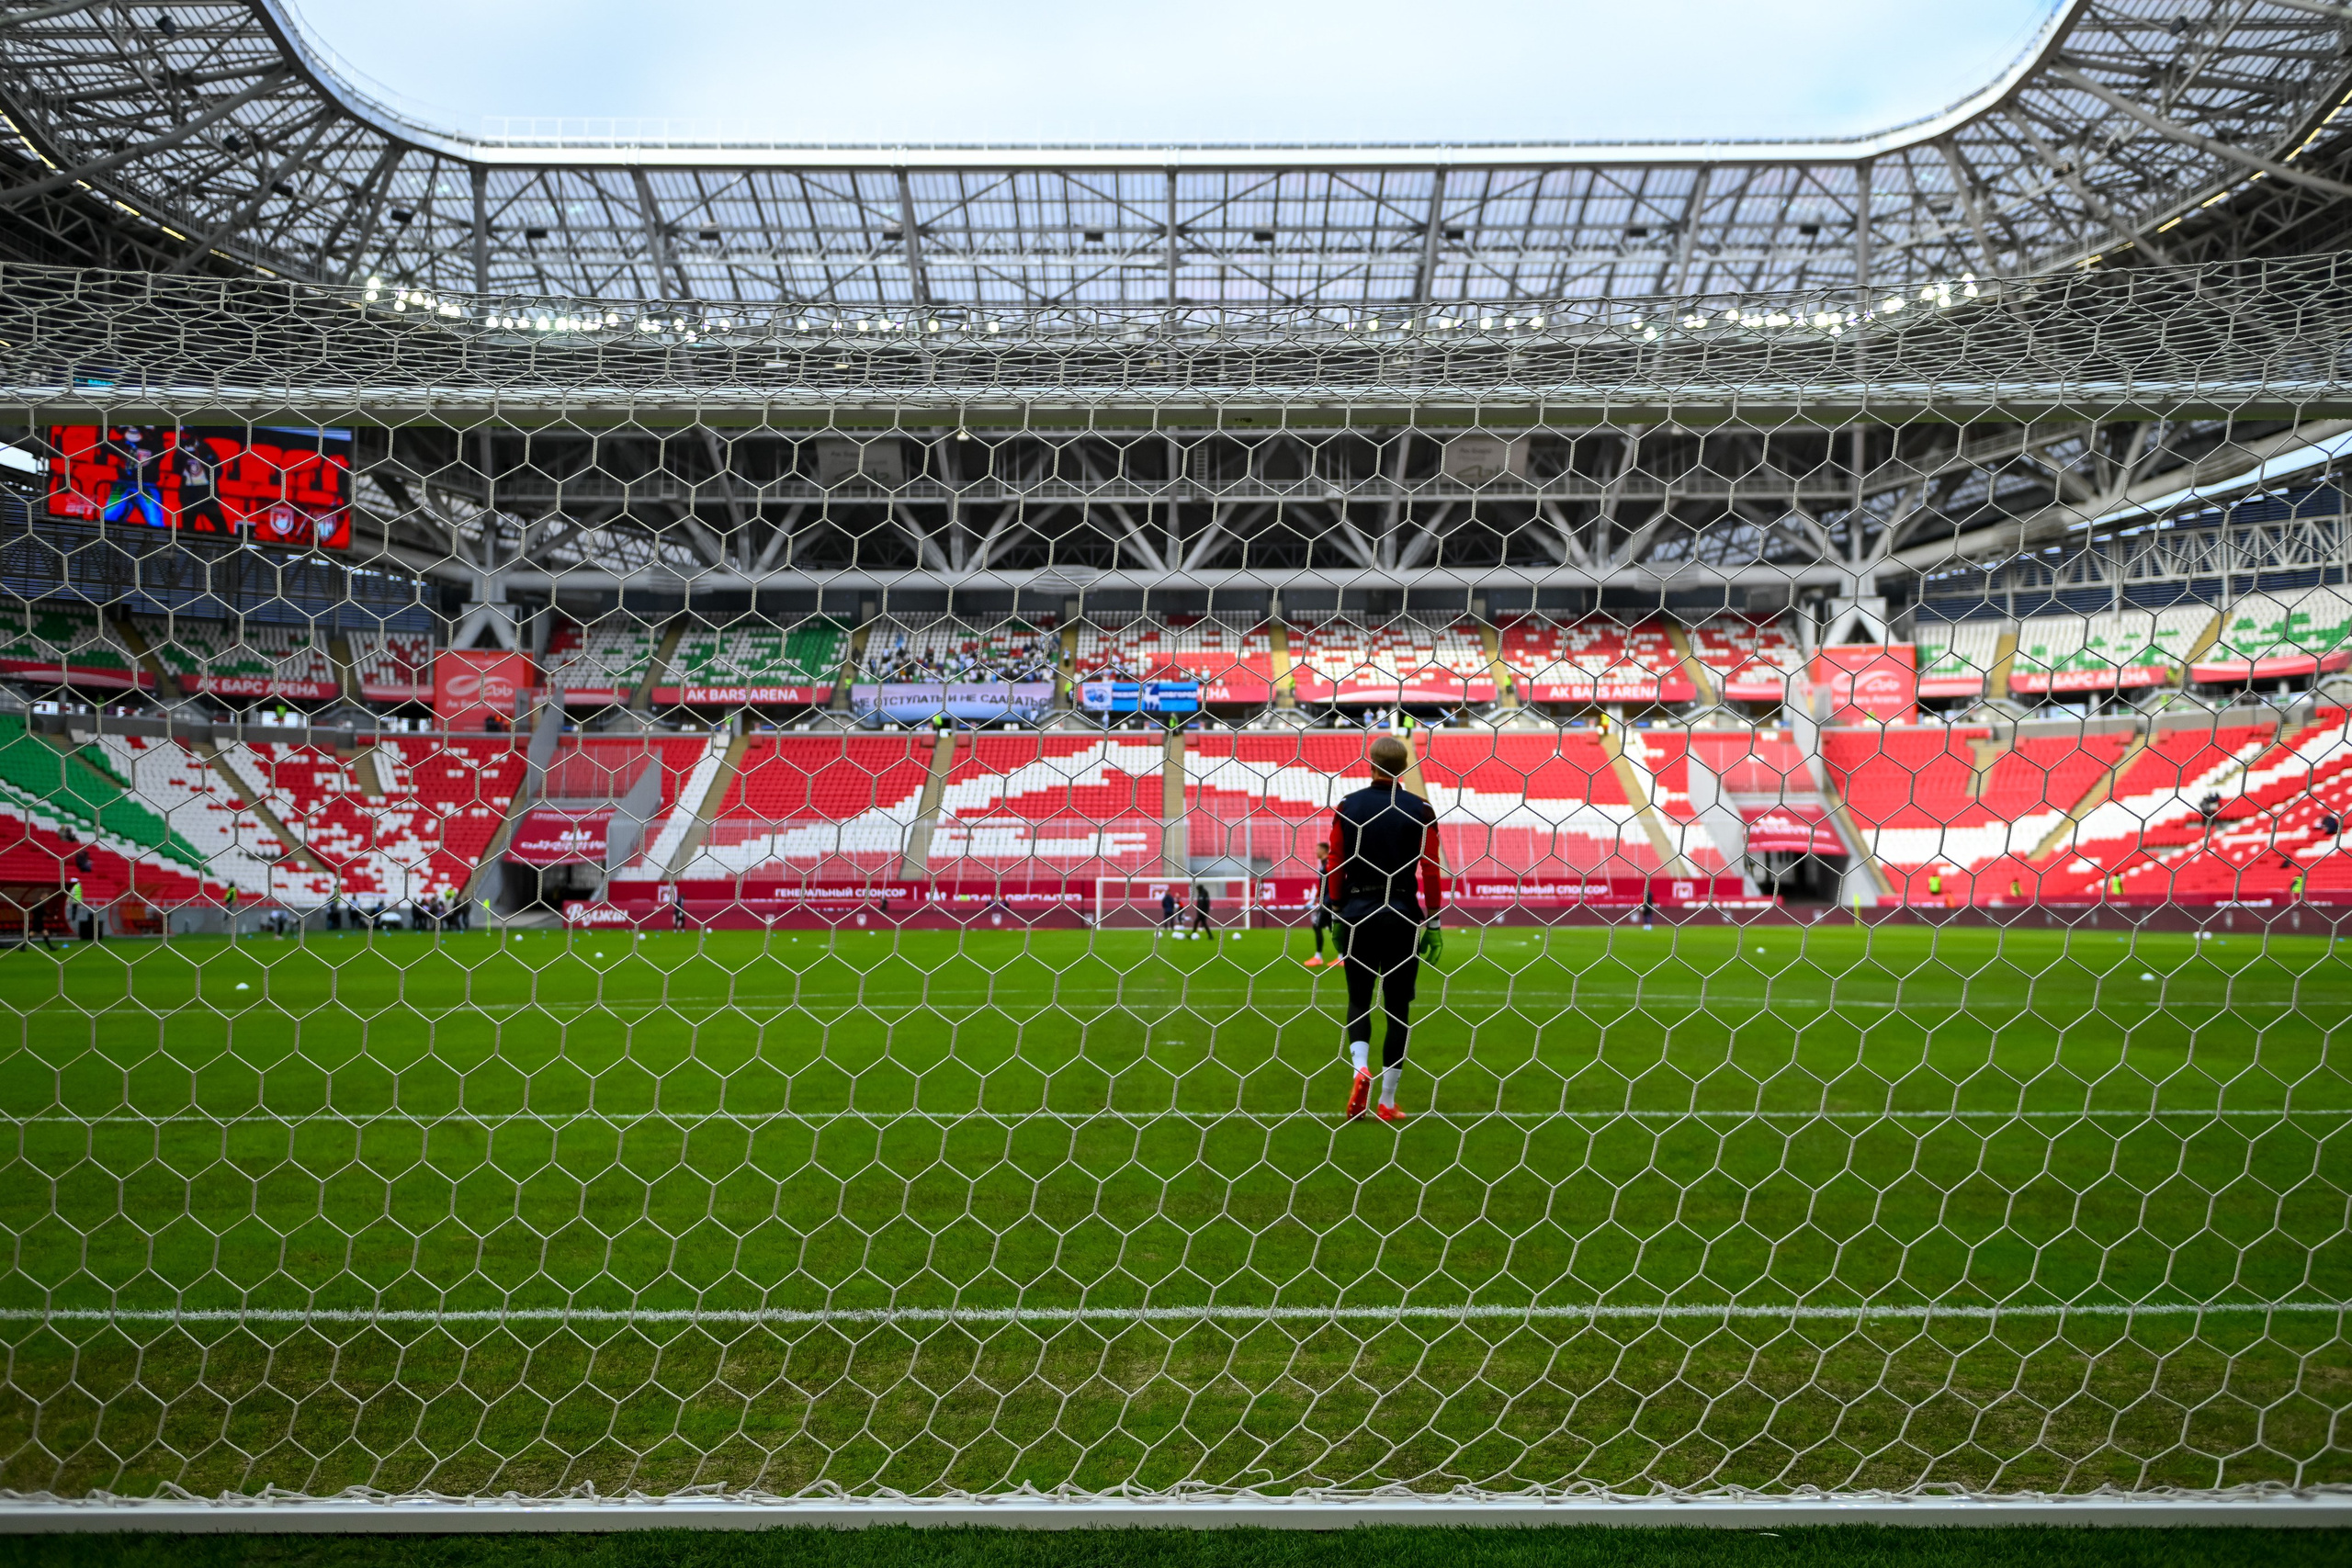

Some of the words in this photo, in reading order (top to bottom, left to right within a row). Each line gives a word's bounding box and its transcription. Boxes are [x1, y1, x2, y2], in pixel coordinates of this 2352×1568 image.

[197, 678, 218, 691] АК
[221, 679, 264, 694] БАРС
[266, 682, 320, 696] АРЕНА
[1549, 685, 1569, 698] AK
[1572, 685, 1610, 698] BARS
[1612, 685, 1661, 698] ARENA
[686, 689, 707, 701] AK
[709, 689, 746, 701] BARS
[750, 689, 798, 701] ARENA
[874, 694, 944, 707] ОТСТУПАТЬ
[960, 694, 977, 703] НЕ
[775, 886, 854, 897] ГЕНЕРАЛЬНЫЙ
[854, 887, 907, 897] СПОНСОР
